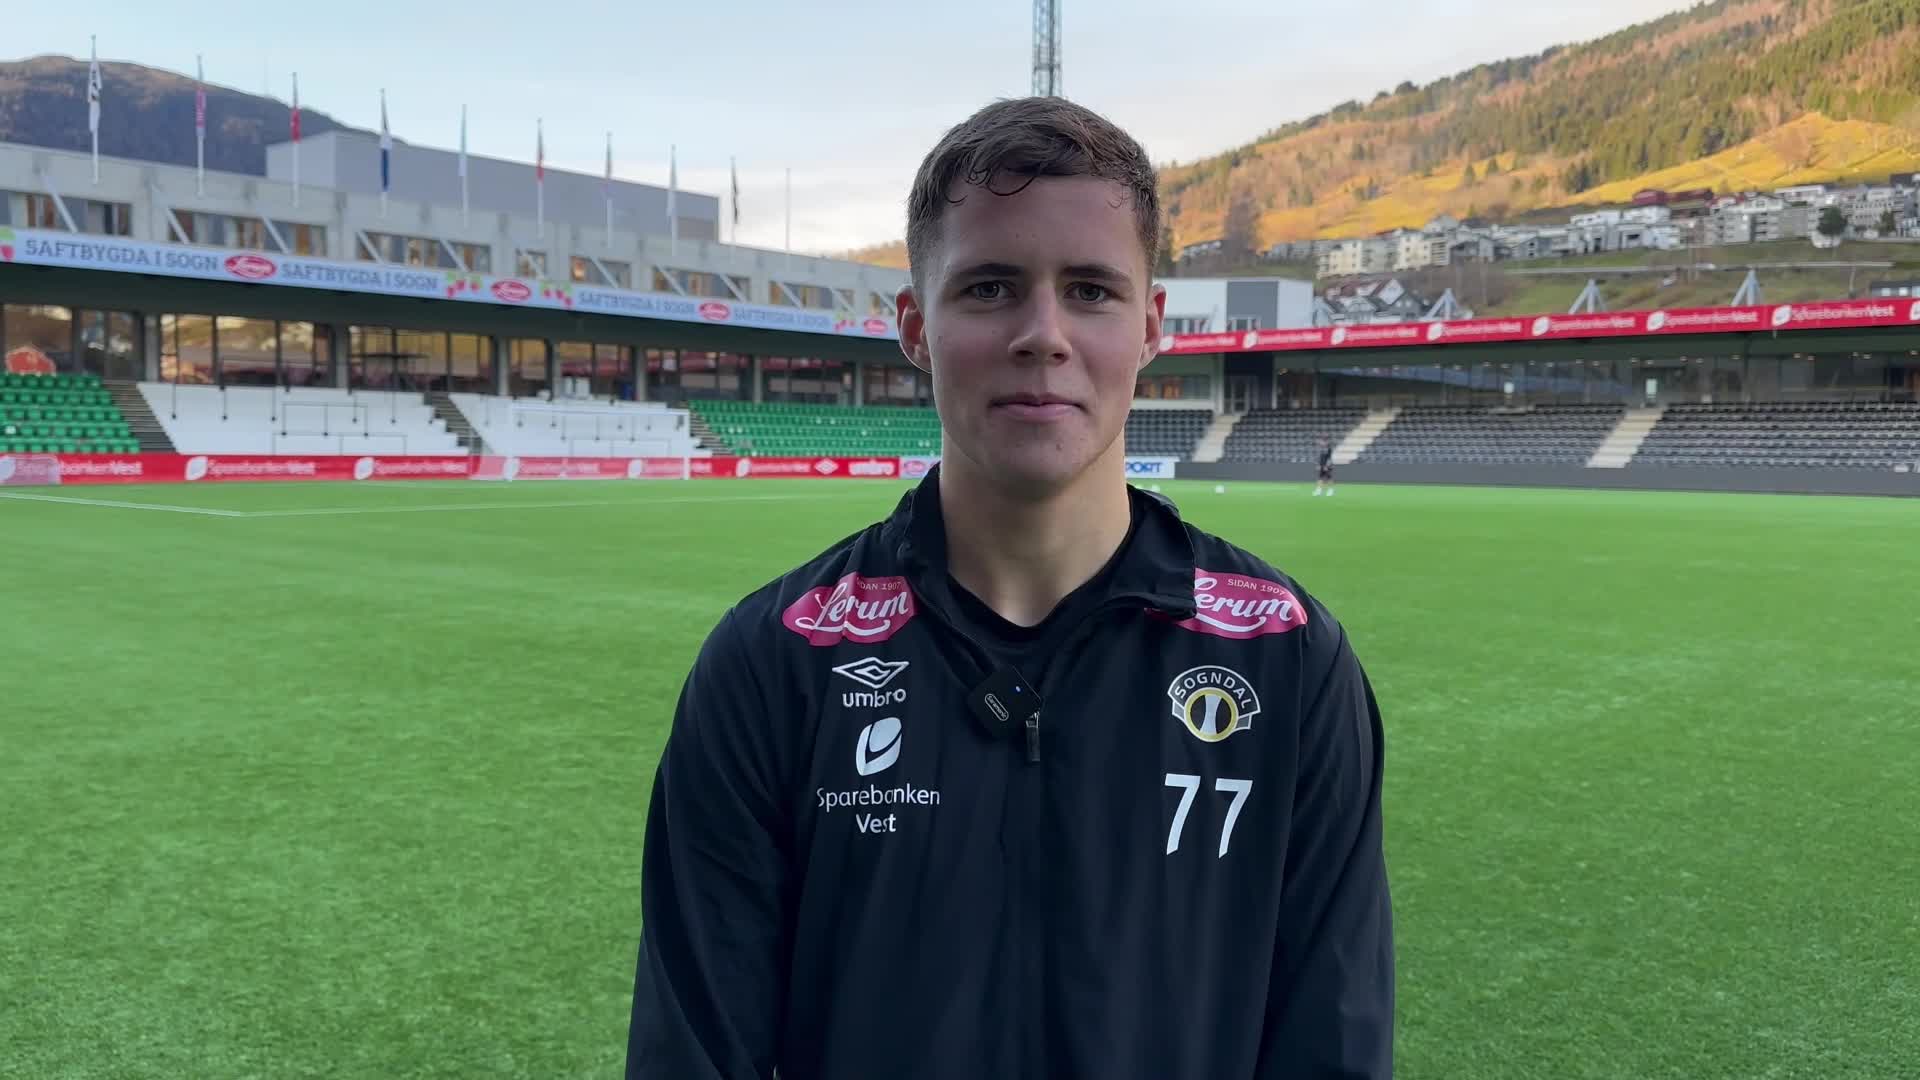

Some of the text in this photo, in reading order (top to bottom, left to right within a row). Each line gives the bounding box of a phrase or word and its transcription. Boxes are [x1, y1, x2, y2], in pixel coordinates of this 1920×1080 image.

[25, 239, 150, 265] SAFTBYGDA
[154, 251, 162, 266] I
[165, 252, 218, 271] SOGN
[280, 263, 380, 287] SAFTBYGDA
[395, 274, 438, 290] SOGN
[1227, 578, 1287, 596] SIDAN 1907
[795, 582, 908, 636] Lerum
[842, 688, 907, 708] umbro
[1174, 671, 1252, 709] SOGNDAL
[816, 783, 941, 812] Sparebanken
[855, 812, 897, 833] Vest
